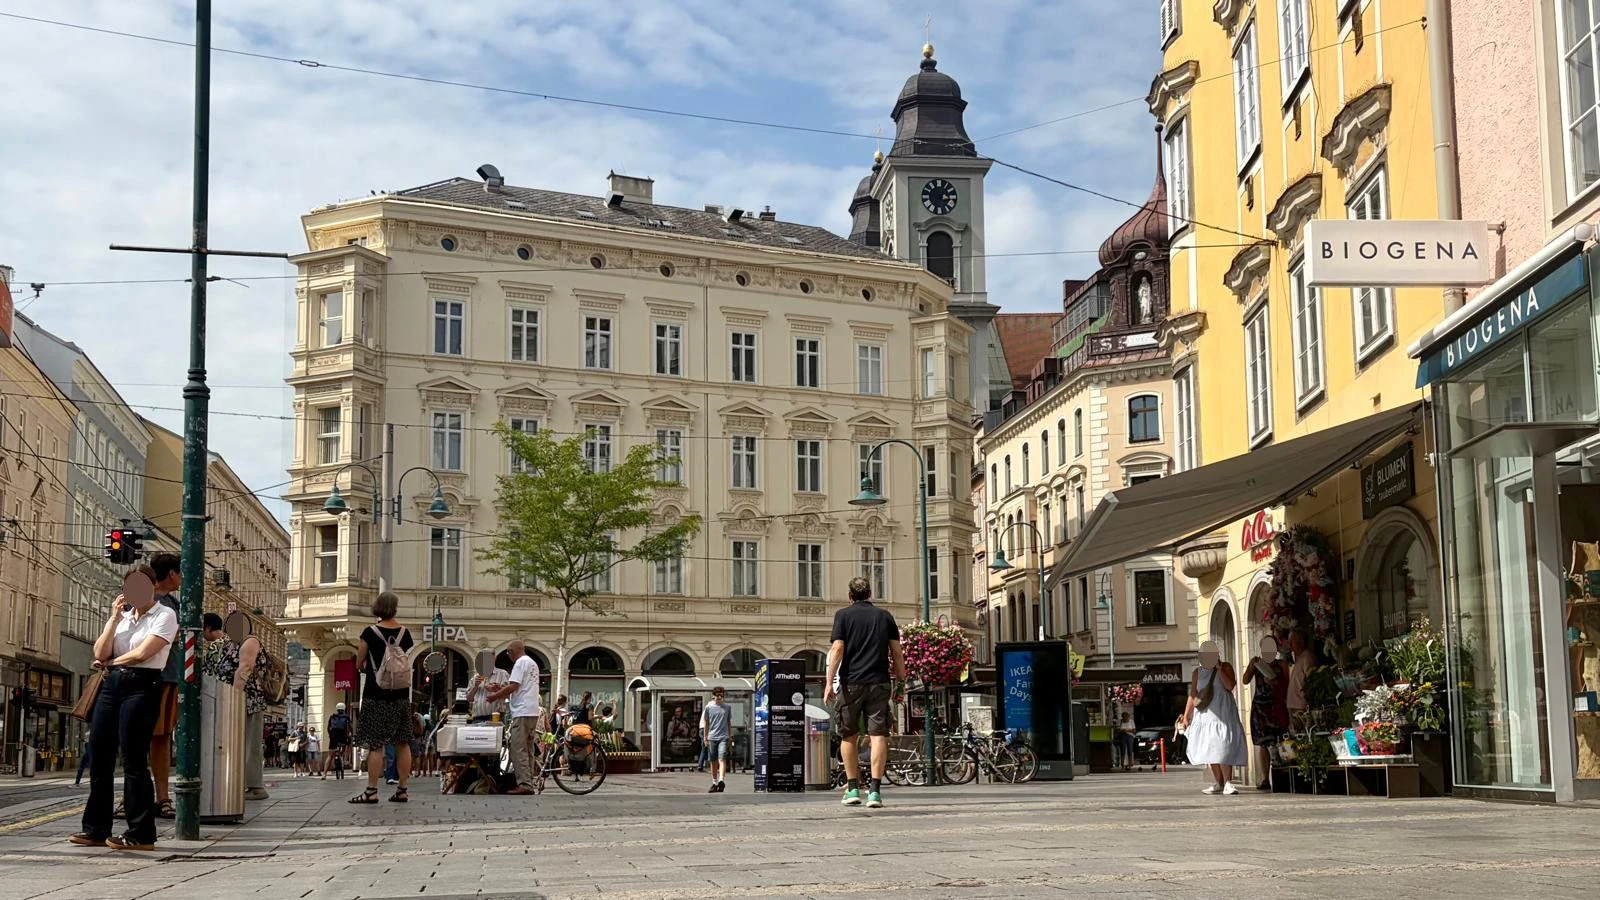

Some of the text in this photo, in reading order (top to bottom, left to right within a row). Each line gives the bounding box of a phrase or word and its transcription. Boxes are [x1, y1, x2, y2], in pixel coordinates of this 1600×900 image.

[1321, 241, 1479, 260] BIOGENA
[1446, 287, 1539, 368] BIOGENA
[1377, 456, 1406, 486] BLUMEN
[423, 626, 468, 641] BIPA
[1010, 665, 1033, 677] IKEA
[335, 680, 351, 689] BIPA
